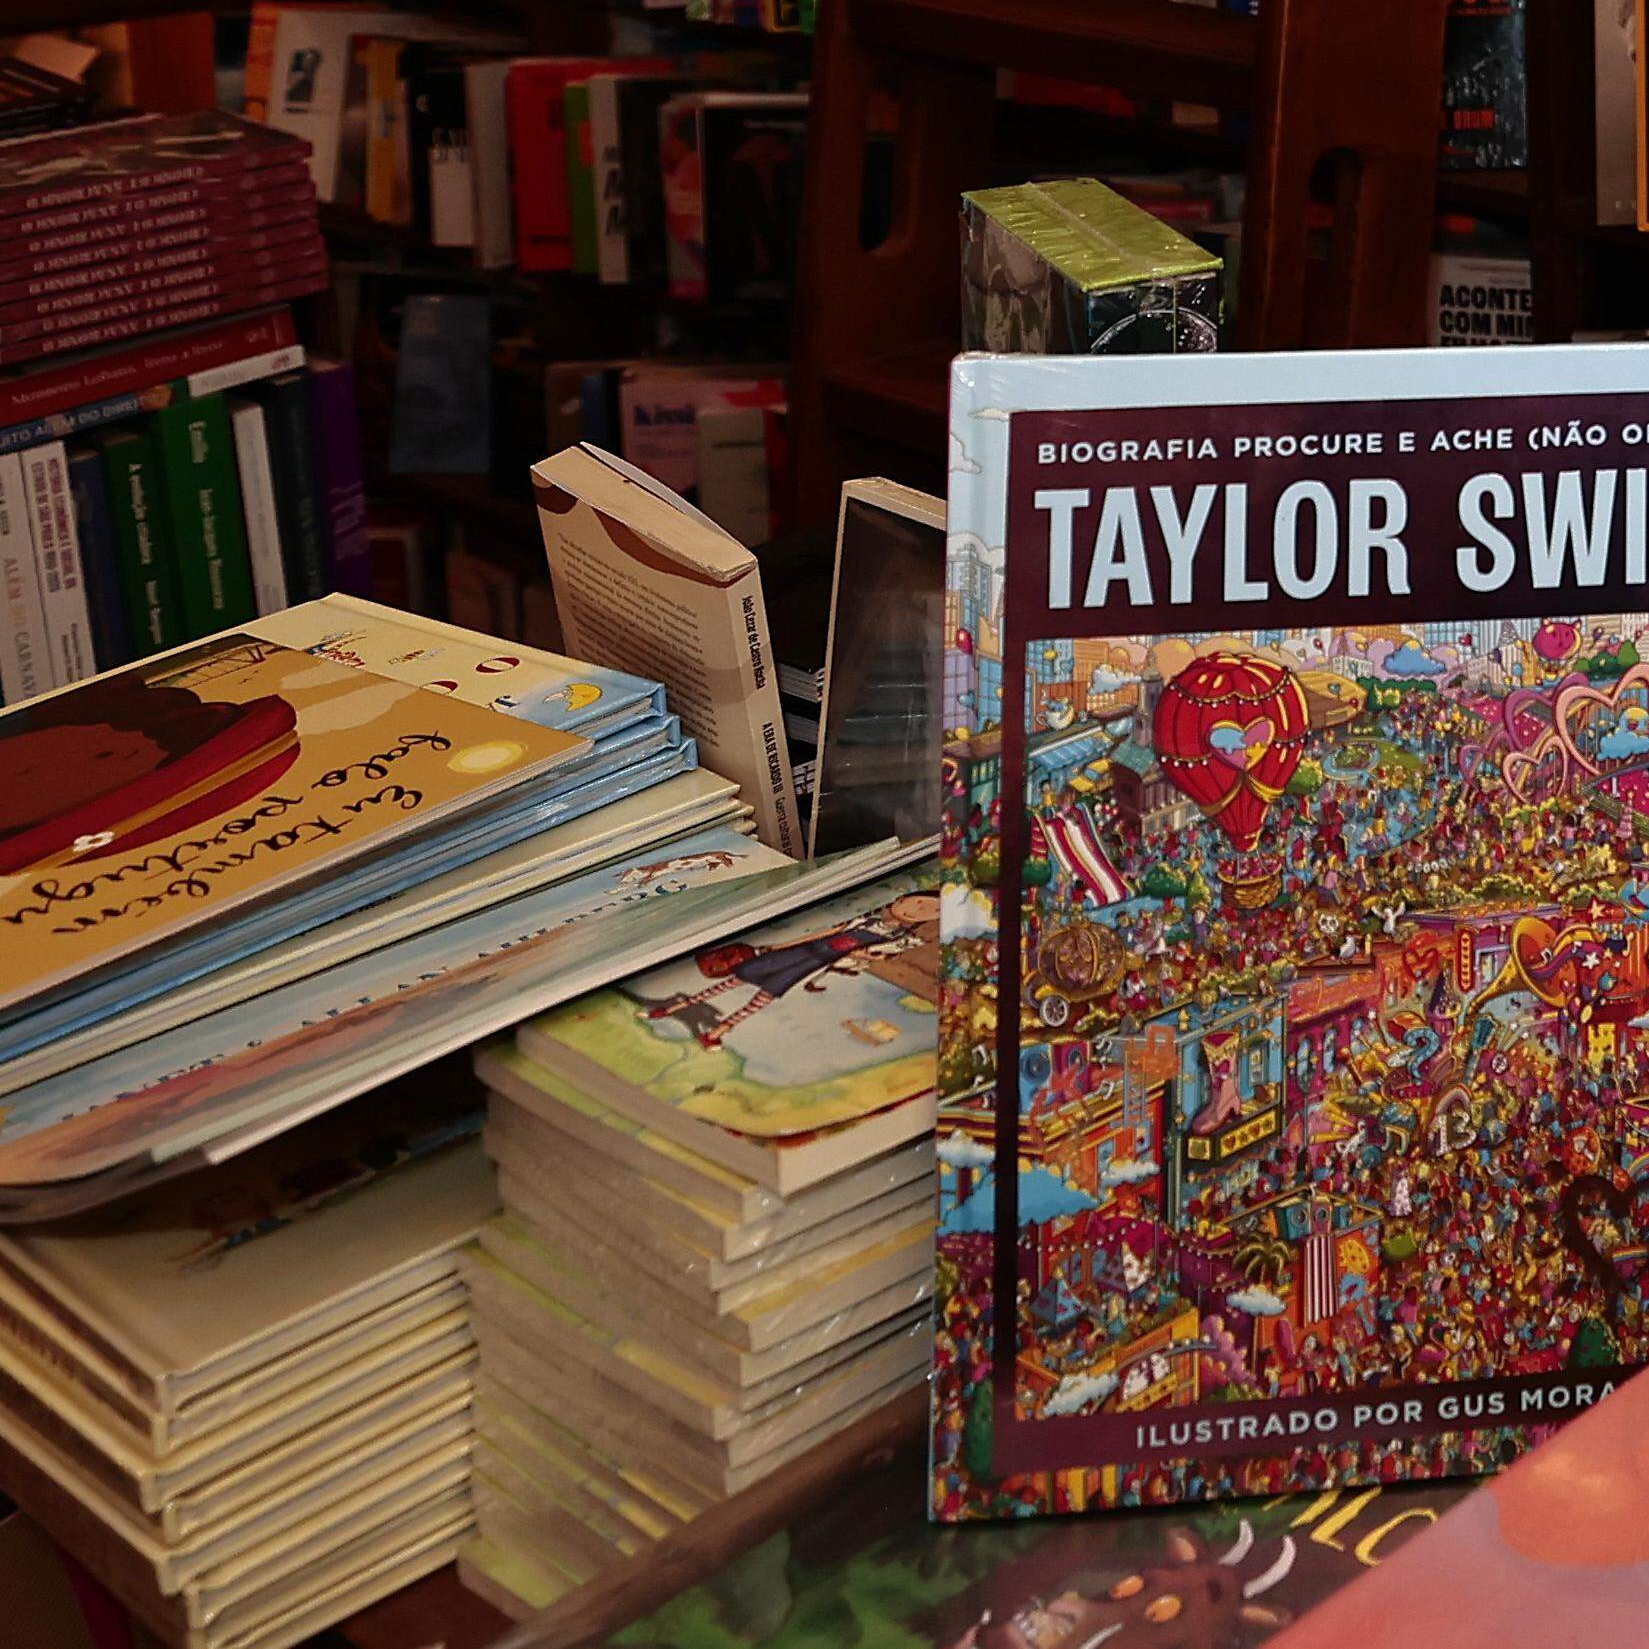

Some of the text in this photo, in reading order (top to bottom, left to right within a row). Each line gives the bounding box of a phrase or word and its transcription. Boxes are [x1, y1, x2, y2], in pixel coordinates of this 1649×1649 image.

[1440, 311, 1491, 335] COM
[1038, 438, 1219, 466] BIOGRAFIA
[1233, 431, 1384, 458] PROCURE
[1399, 431, 1416, 454] E
[1430, 427, 1514, 454] ACHE
[1528, 420, 1608, 452] (NÃO
[1034, 478, 1411, 610] TAYLOR
[1136, 1405, 1338, 1450] ILUSTRADO
[1353, 1398, 1420, 1430] POR
[1439, 1392, 1507, 1420] GUS
